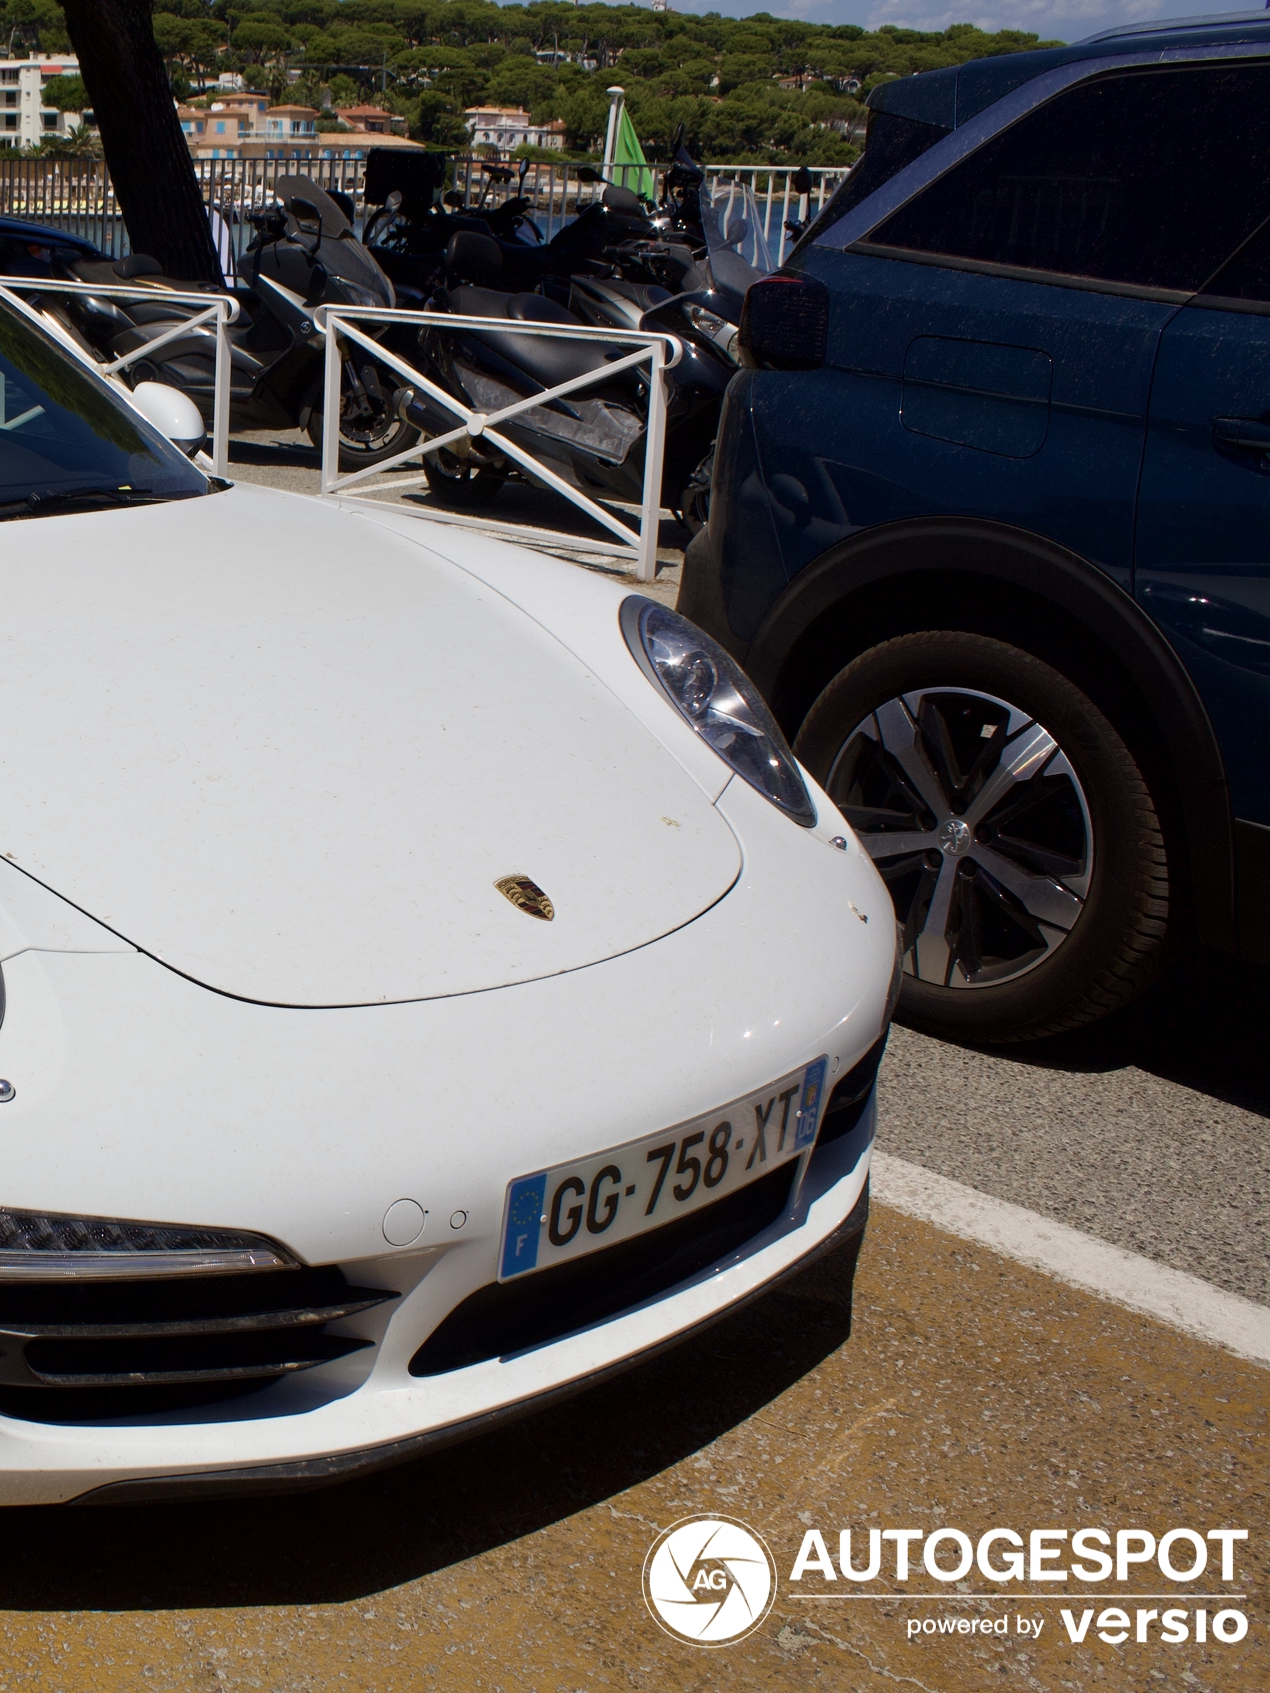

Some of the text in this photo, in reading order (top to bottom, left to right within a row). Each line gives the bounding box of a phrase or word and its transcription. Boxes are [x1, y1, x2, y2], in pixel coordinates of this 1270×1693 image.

[515, 1084, 817, 1257] F GG-758-XT 06
